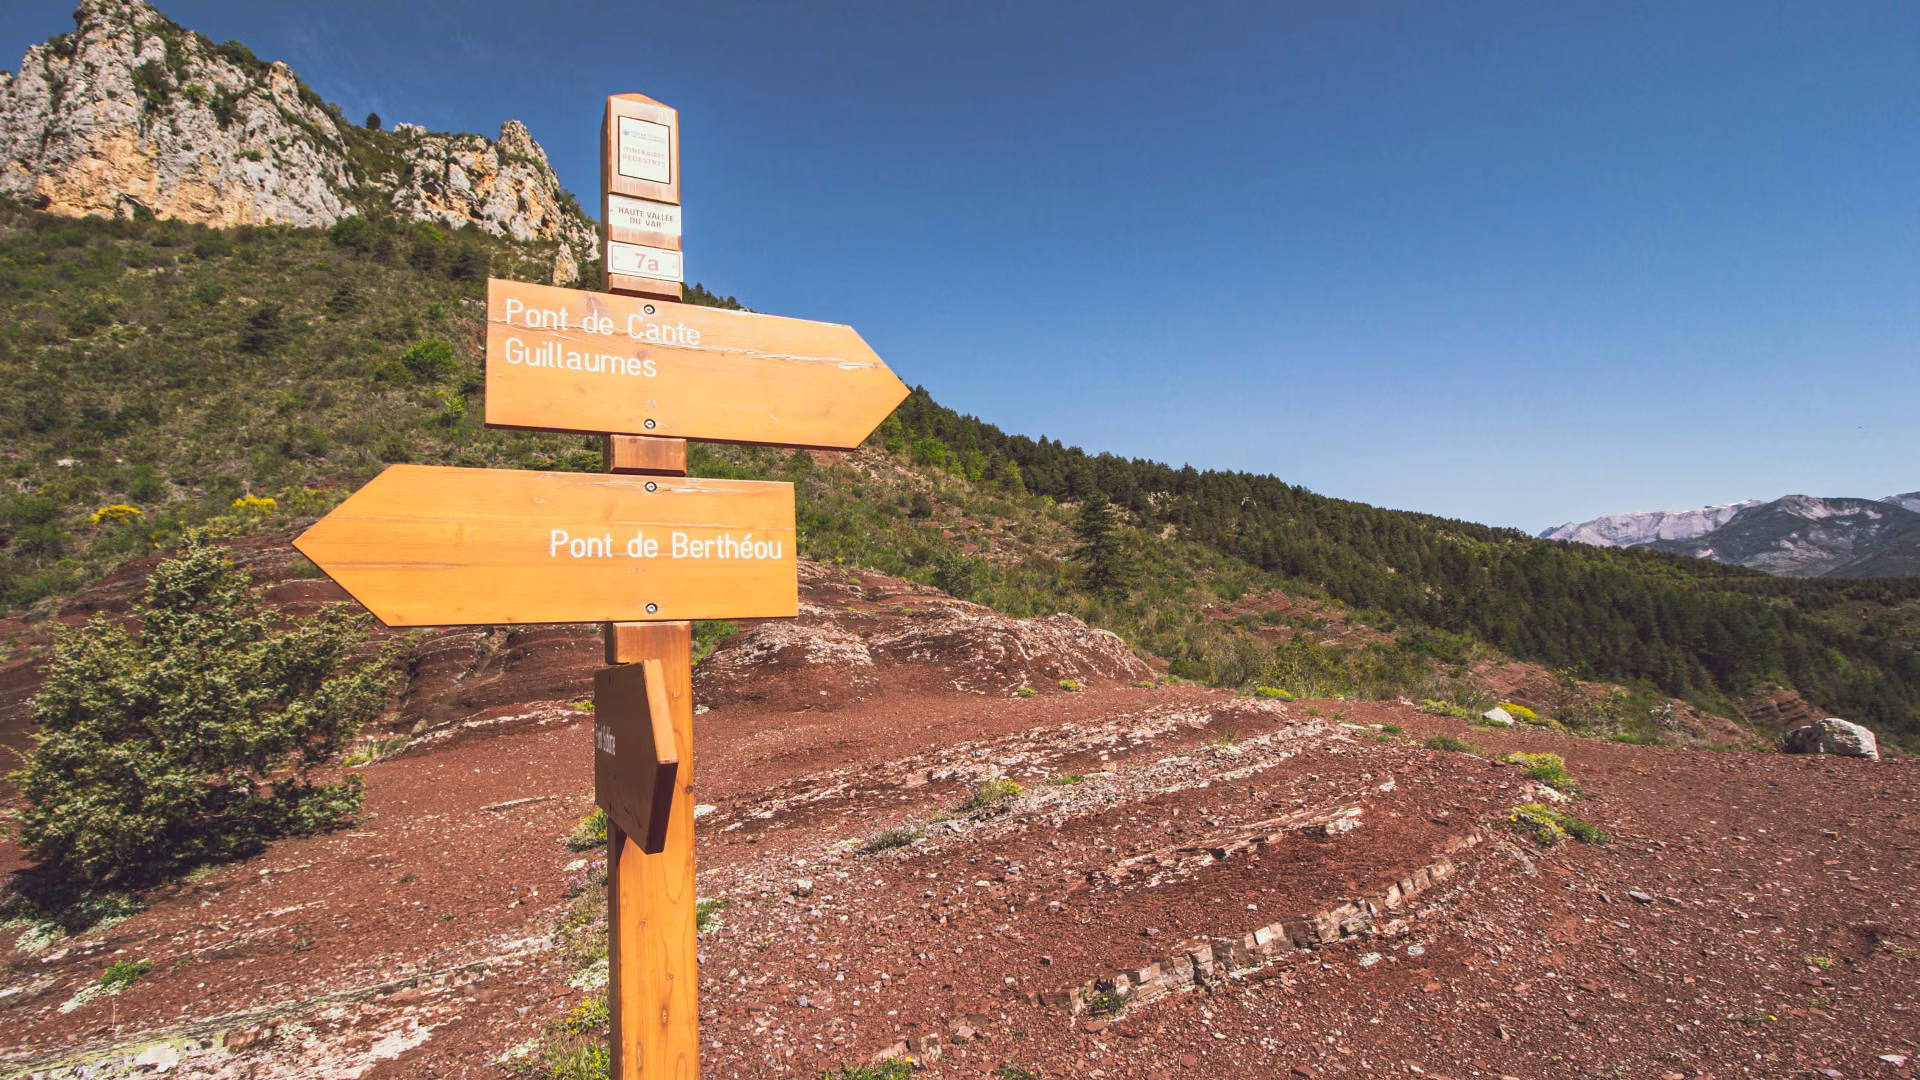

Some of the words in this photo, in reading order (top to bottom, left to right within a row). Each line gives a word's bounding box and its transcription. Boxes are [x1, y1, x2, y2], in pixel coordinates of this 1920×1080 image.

[618, 207, 644, 218] HAUTE
[629, 217, 641, 225] DU
[645, 220, 661, 229] VAR
[634, 253, 659, 272] 7a
[505, 297, 569, 331] Pont
[583, 309, 614, 336] de
[627, 313, 701, 346] Cante
[505, 337, 657, 378] Guillaumes
[550, 529, 613, 558] Pont
[627, 531, 658, 558] de
[672, 531, 782, 559] Berthéou
